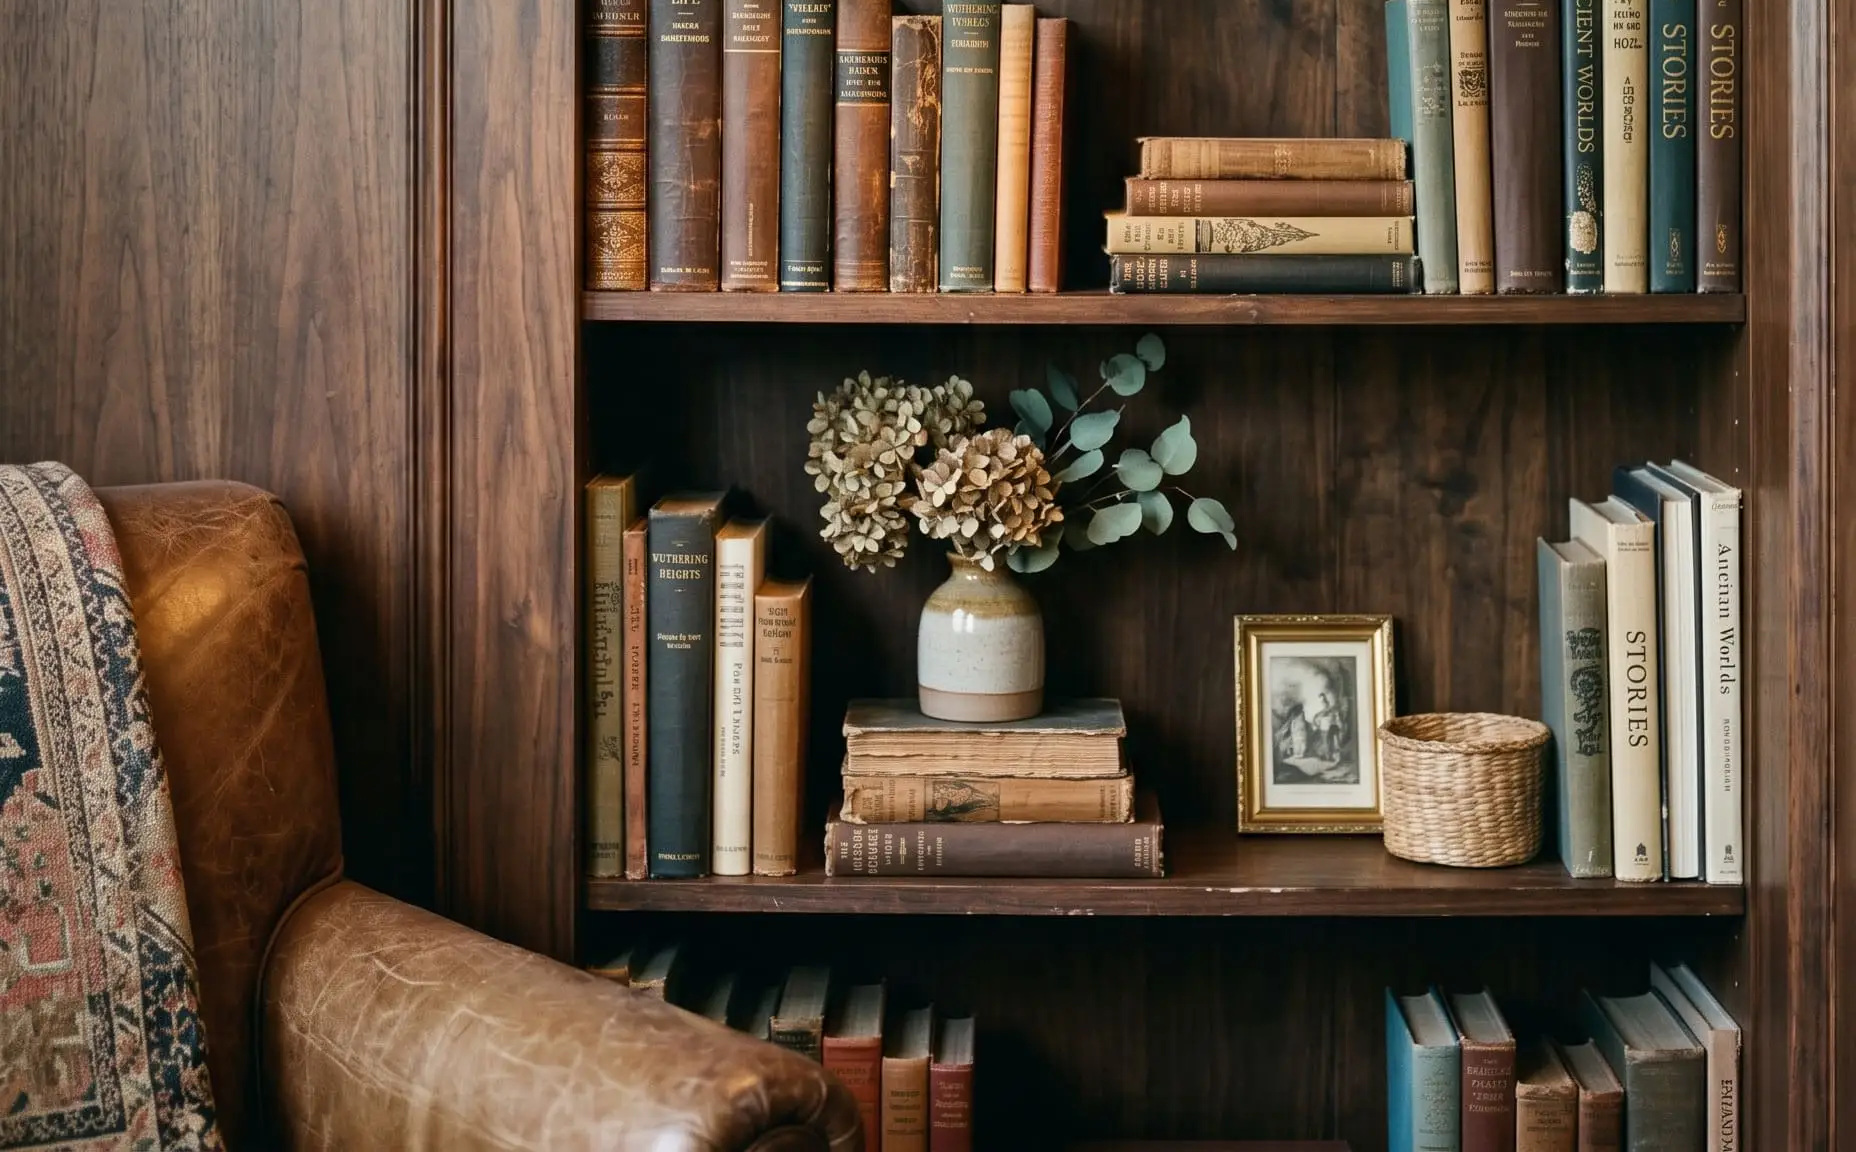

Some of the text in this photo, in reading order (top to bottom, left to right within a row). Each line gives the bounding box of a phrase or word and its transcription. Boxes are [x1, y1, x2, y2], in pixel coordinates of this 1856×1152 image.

[1577, 65, 1595, 153] WORLDS
[1662, 23, 1687, 139] STORIES
[1710, 23, 1735, 140] STORIES
[1626, 631, 1649, 747] STORIES
[1719, 627, 1736, 695] Worlds
